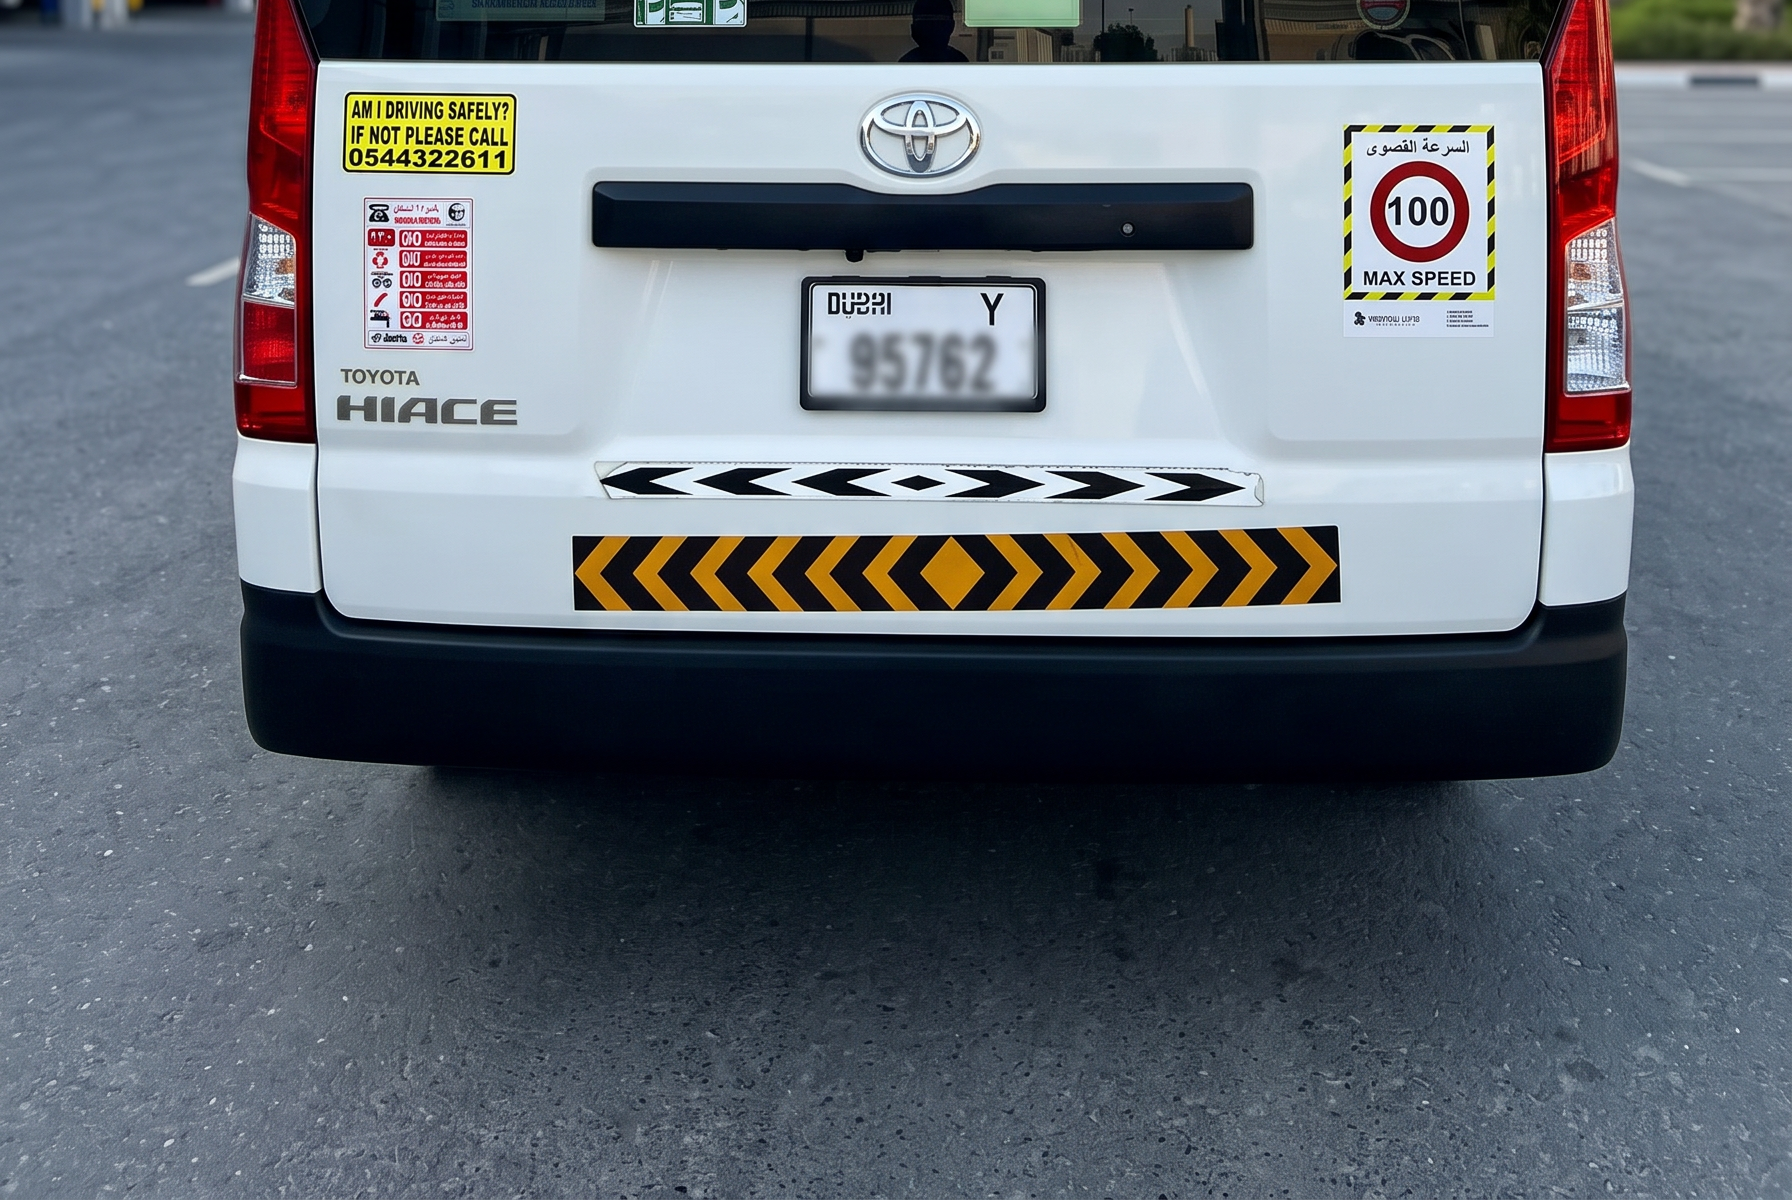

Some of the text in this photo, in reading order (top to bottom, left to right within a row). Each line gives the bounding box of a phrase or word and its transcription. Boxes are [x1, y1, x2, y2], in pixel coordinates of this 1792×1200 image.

[352, 101, 509, 120] AM I DRIVING SAFELY?
[351, 126, 508, 147] IF NOT PLEASE CALL
[1366, 138, 1470, 156] السرعة القصوى
[349, 148, 506, 169] 0544322611
[1388, 196, 1449, 226] 100
[1363, 271, 1476, 286] MAX SPEED
[980, 293, 1004, 326] Y
[340, 368, 420, 386] TOYOTA
[337, 395, 517, 425] HIACE
